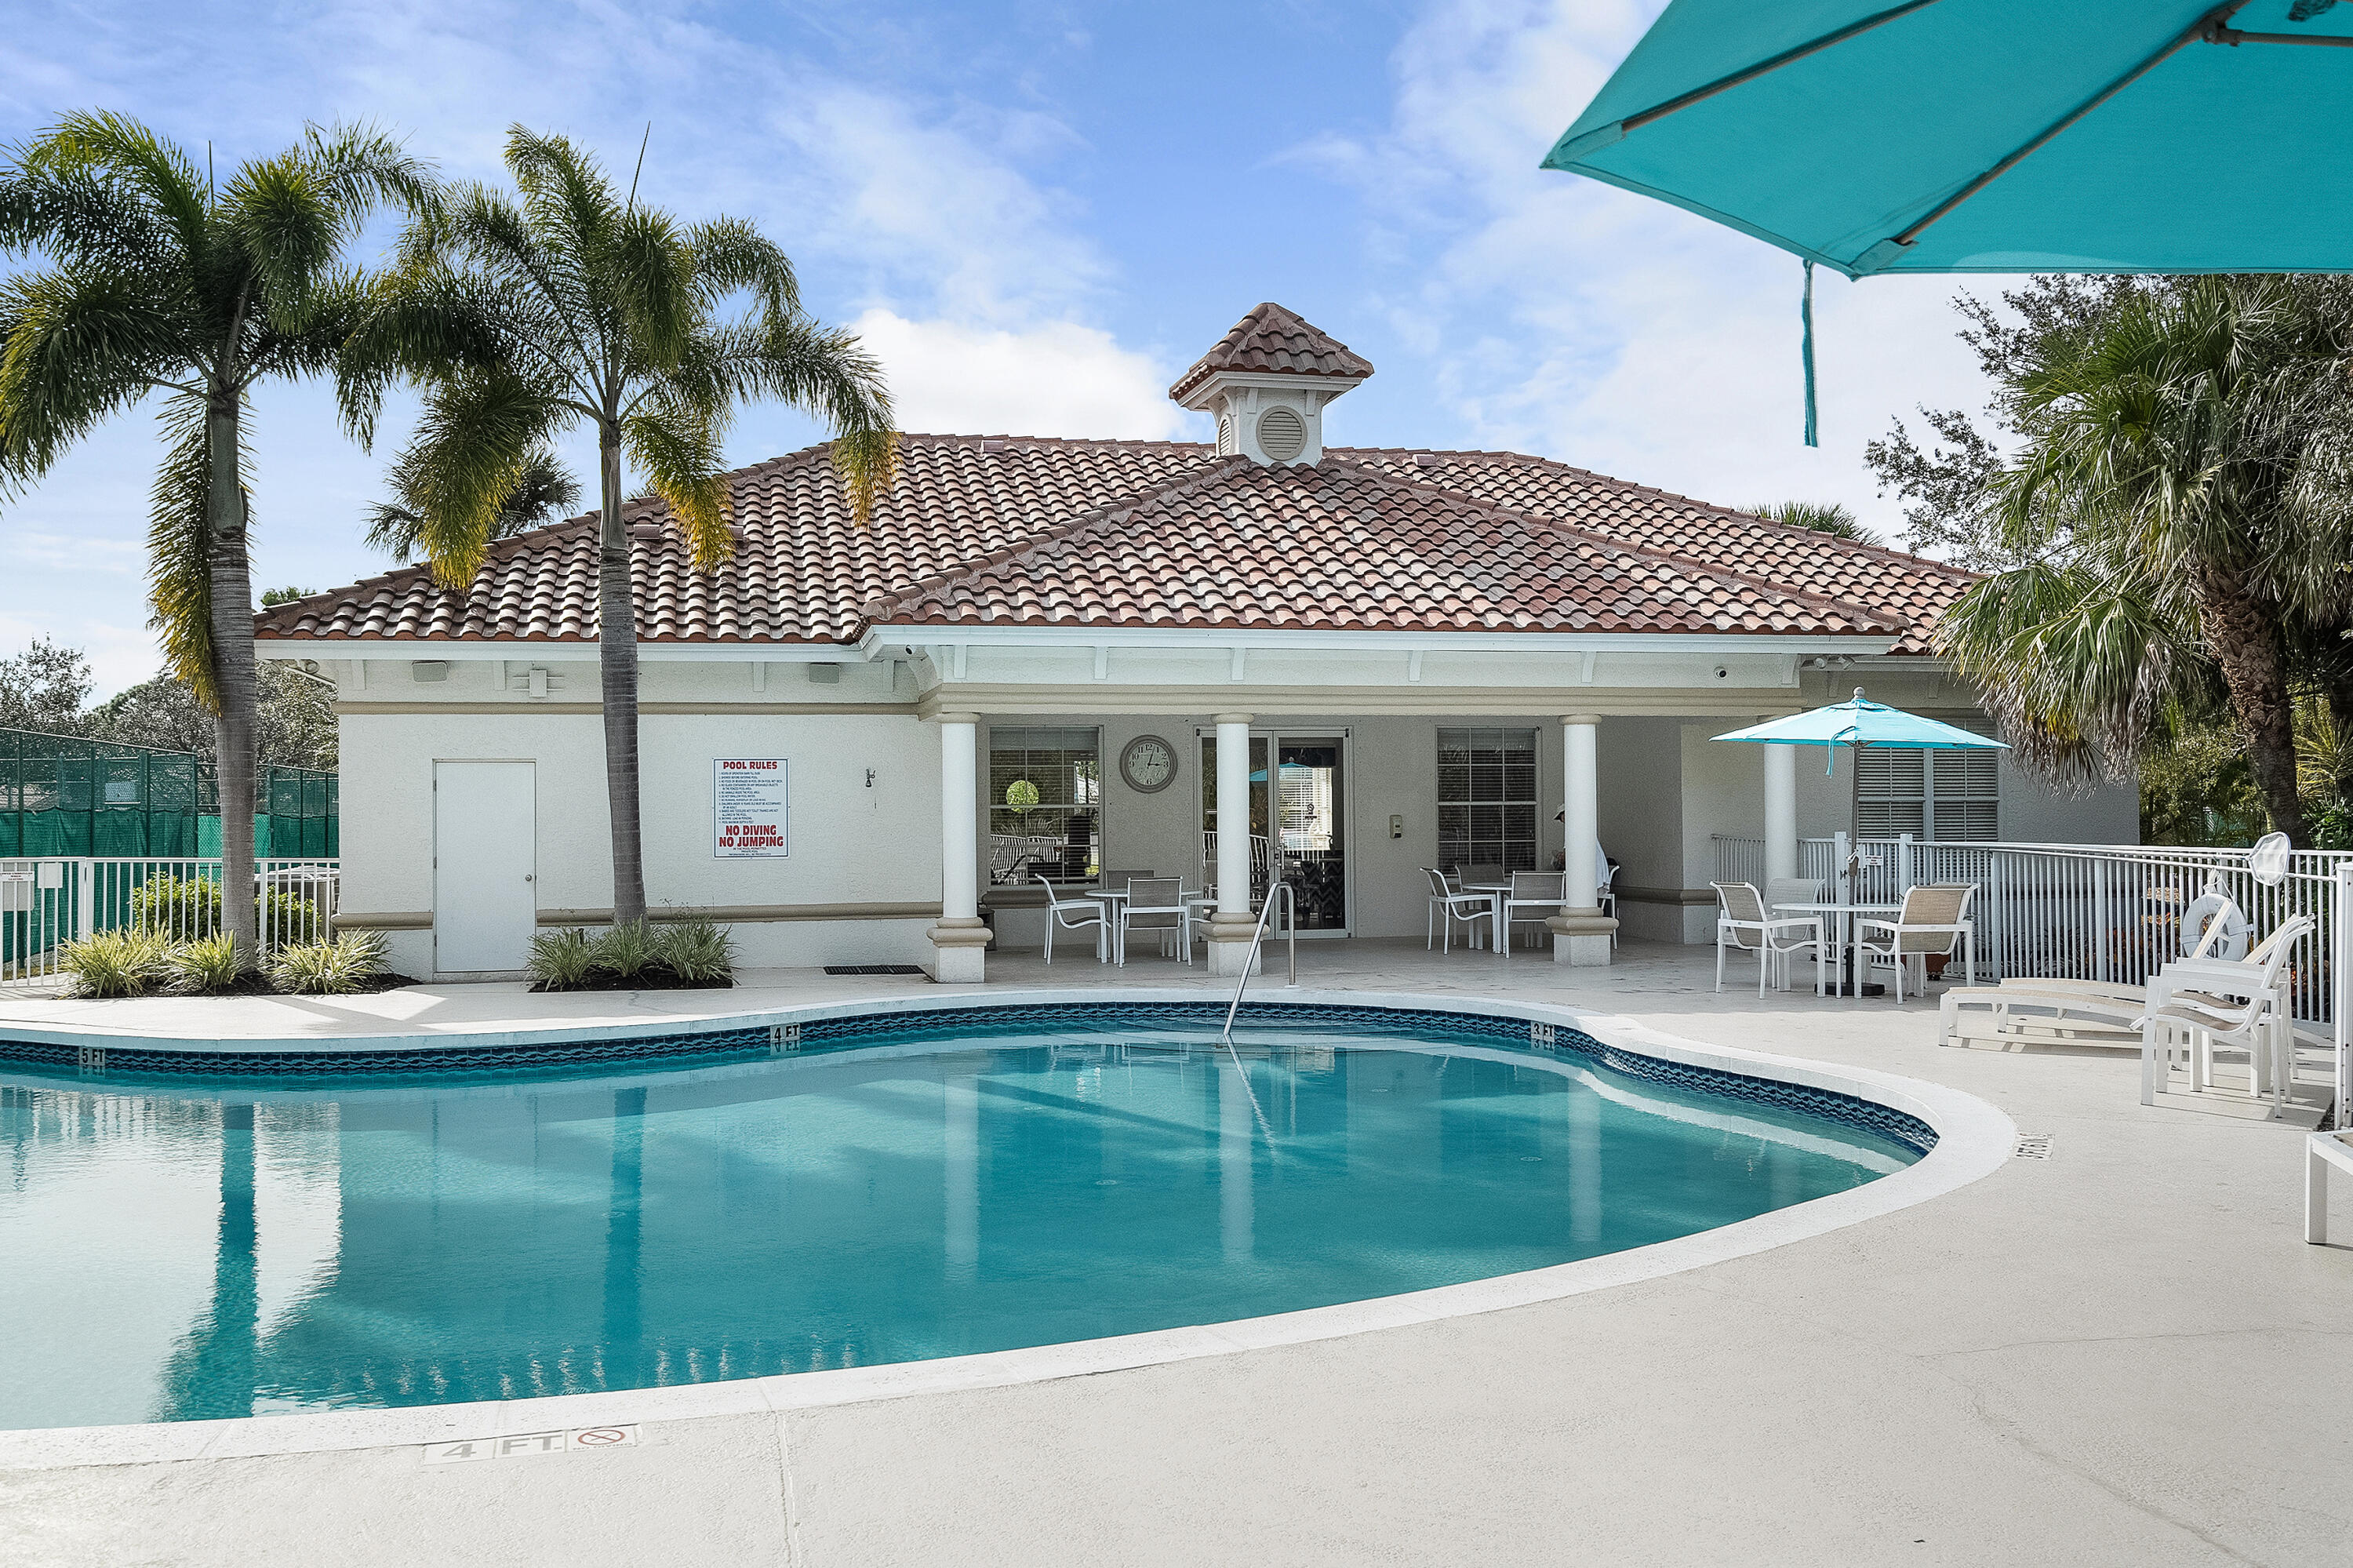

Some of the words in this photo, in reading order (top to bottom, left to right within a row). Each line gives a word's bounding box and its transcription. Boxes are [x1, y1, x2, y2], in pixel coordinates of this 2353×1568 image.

[726, 825, 740, 835] NO
[743, 825, 776, 835] DIVING
[719, 837, 734, 847] NO
[737, 836, 784, 847] JUMPING
[775, 1028, 781, 1042] 4
[787, 1024, 798, 1037] FT
[1534, 1023, 1540, 1035] 3
[1544, 1024, 1553, 1036] FT
[82, 1048, 88, 1063] 5
[93, 1049, 104, 1062] FT
[442, 1443, 477, 1458] 4
[502, 1435, 563, 1455] FT.
